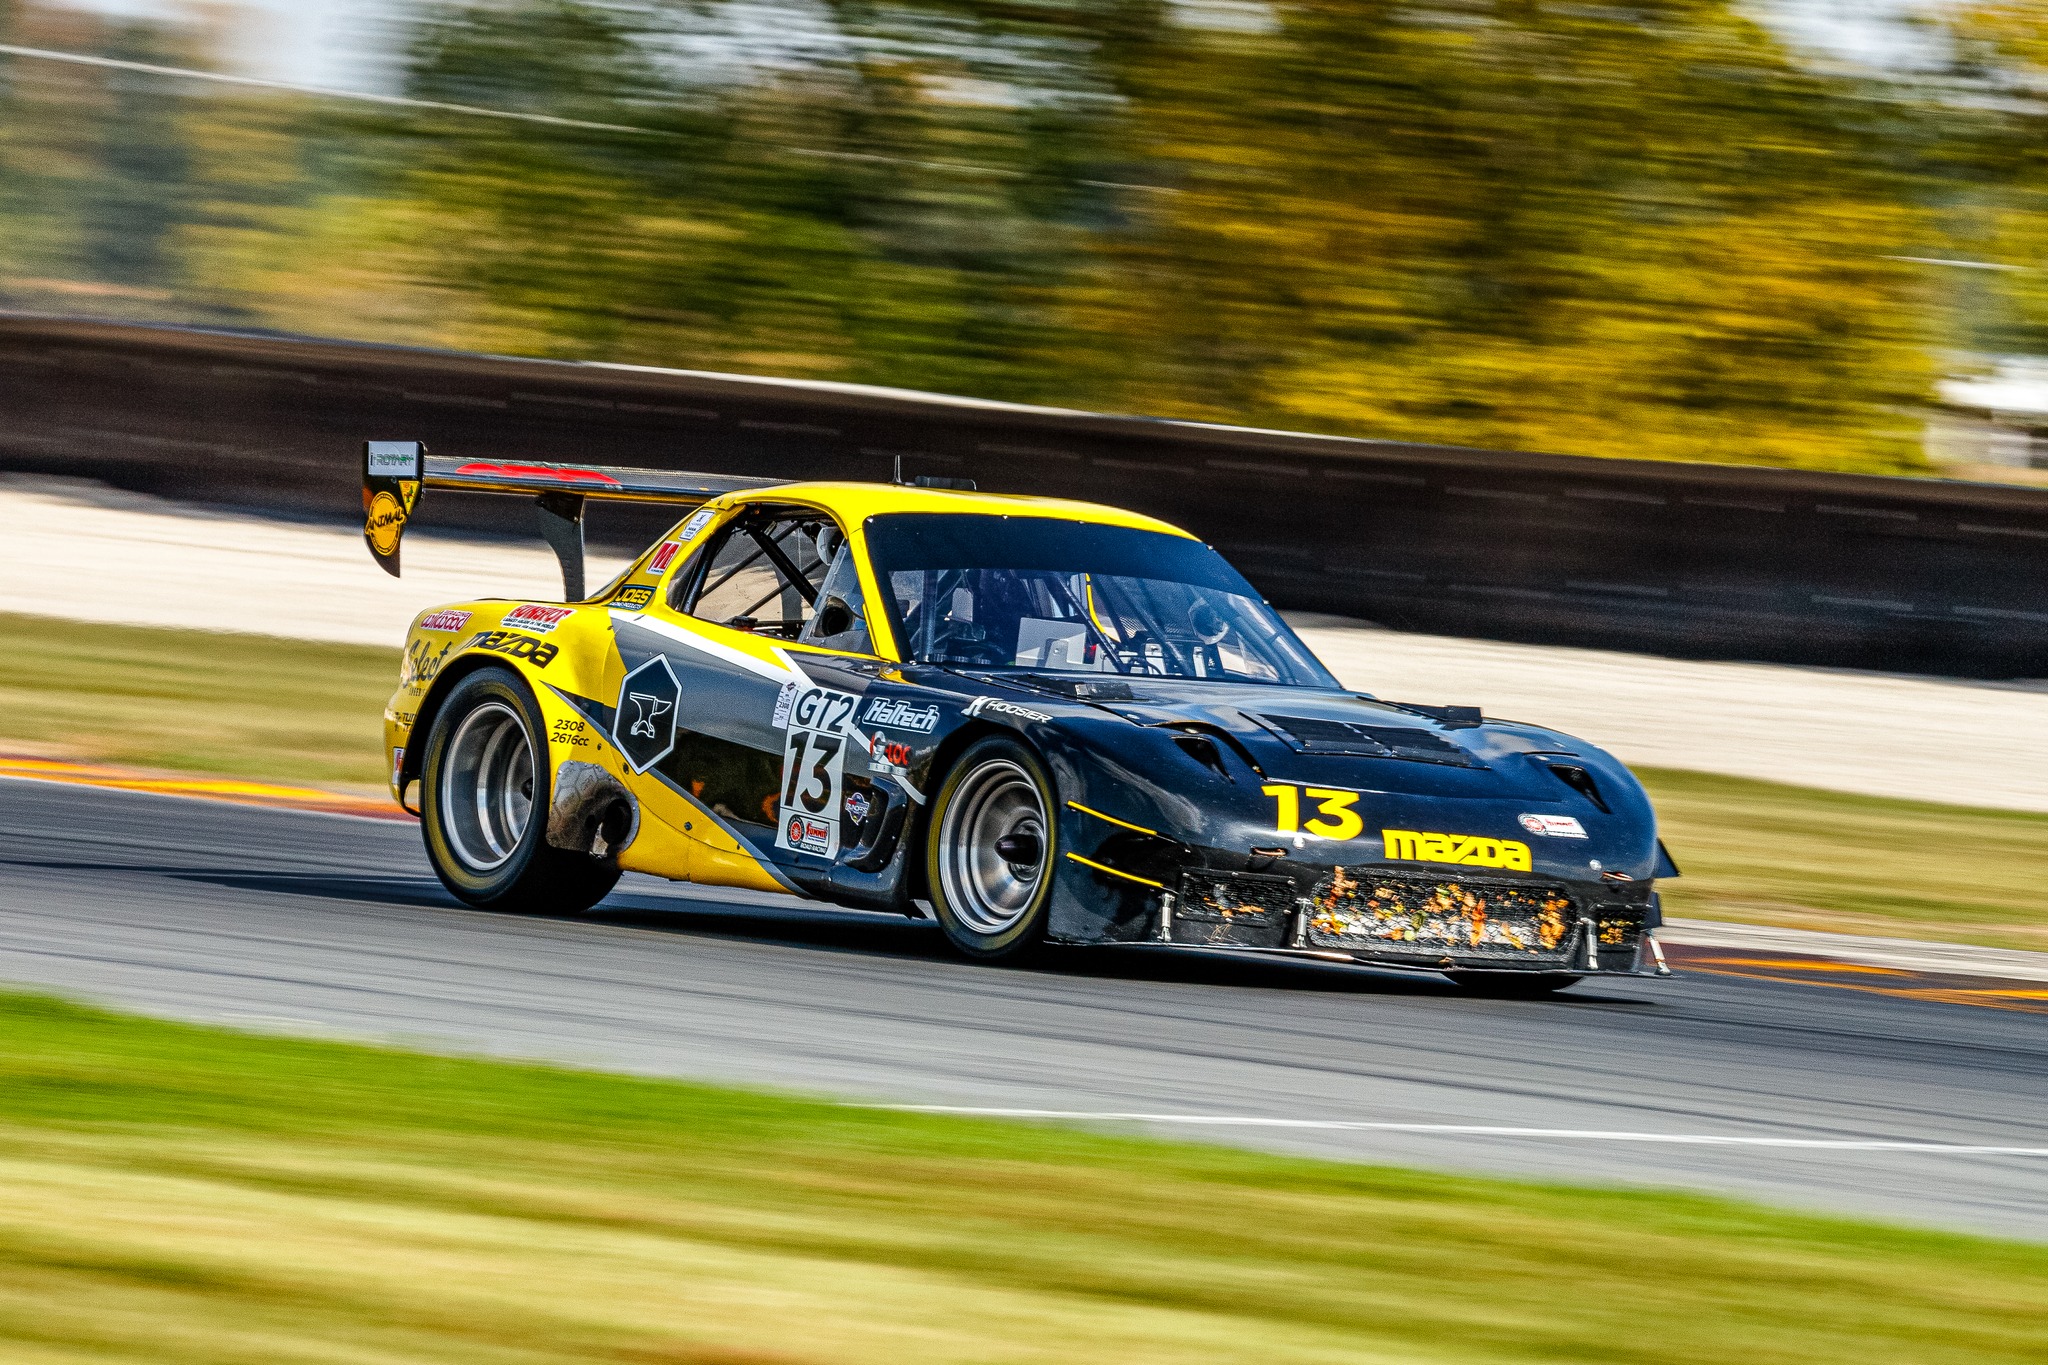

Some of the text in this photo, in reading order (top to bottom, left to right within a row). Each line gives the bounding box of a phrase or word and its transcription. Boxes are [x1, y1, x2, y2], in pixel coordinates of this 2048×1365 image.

[615, 589, 652, 604] JOES
[796, 688, 854, 733] GT2
[866, 699, 938, 731] Haltech
[986, 701, 1053, 723] HOOSIER
[550, 732, 589, 746] 2616cc
[554, 719, 585, 732] 2308
[784, 731, 842, 814] 13
[1262, 784, 1364, 841] 13
